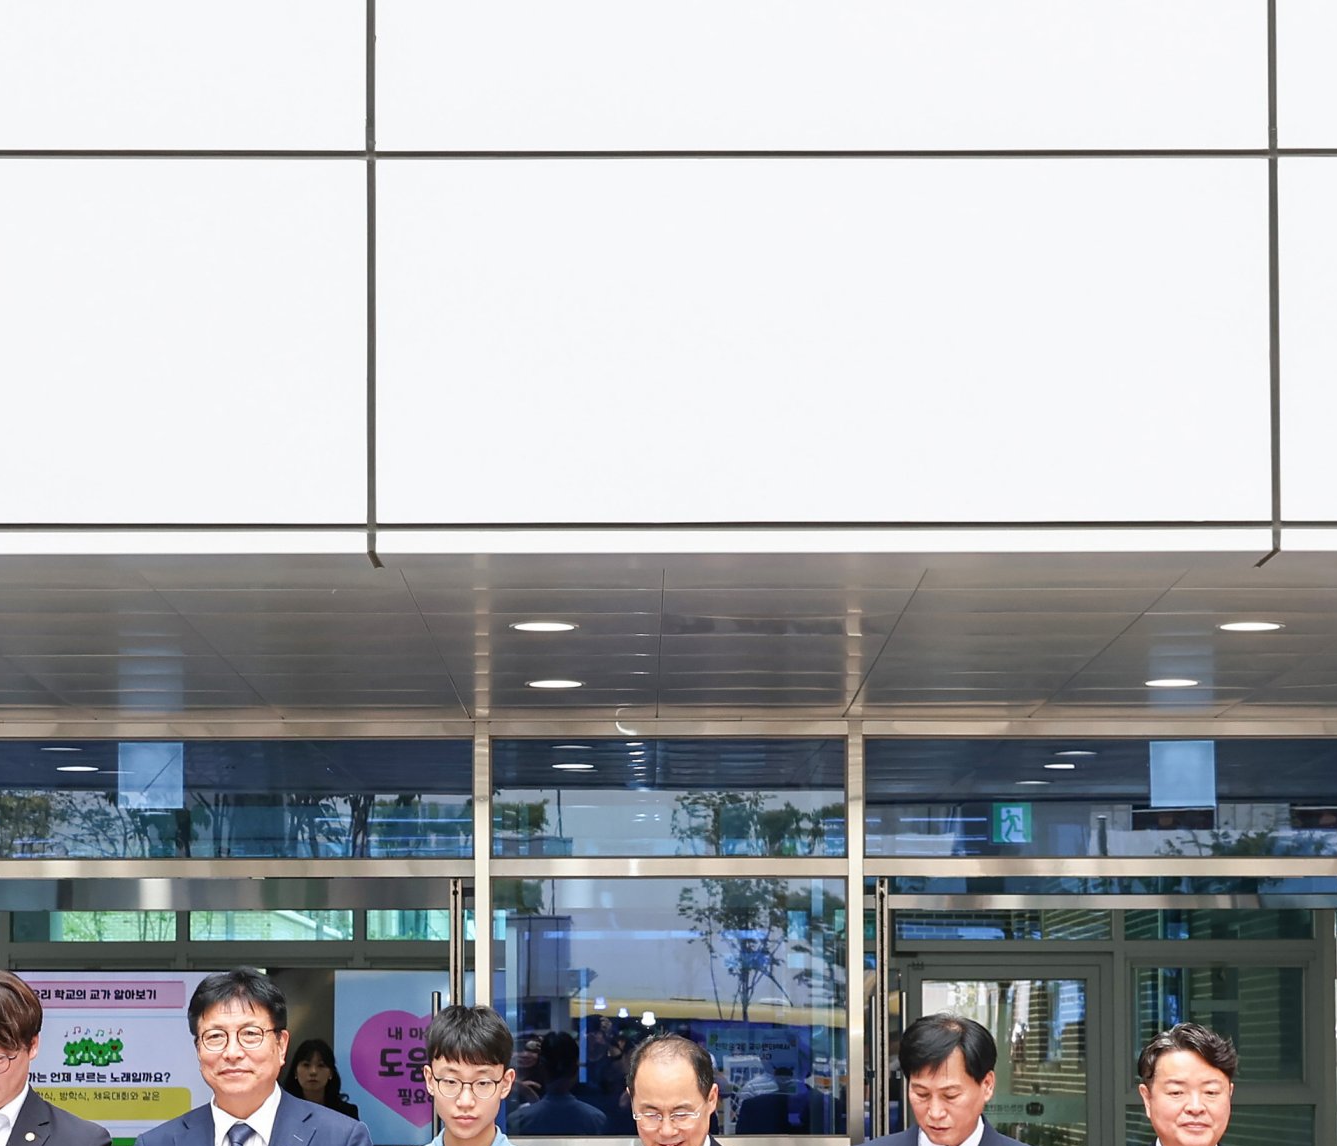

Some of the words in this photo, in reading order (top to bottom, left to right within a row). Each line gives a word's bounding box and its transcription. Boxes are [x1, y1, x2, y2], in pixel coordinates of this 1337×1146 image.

[54, 989, 86, 1000] 학교의
[90, 989, 111, 1000] 교가
[114, 989, 157, 1000] 알아보기
[388, 1026, 403, 1040] 내
[50, 1072, 71, 1082] 언제
[75, 1072, 107, 1082] 부르는
[110, 1072, 171, 1083] 노래일까요?
[59, 1091, 90, 1101] 방학식,
[93, 1091, 139, 1101] 체육대회와
[142, 1091, 161, 1101] 같은
